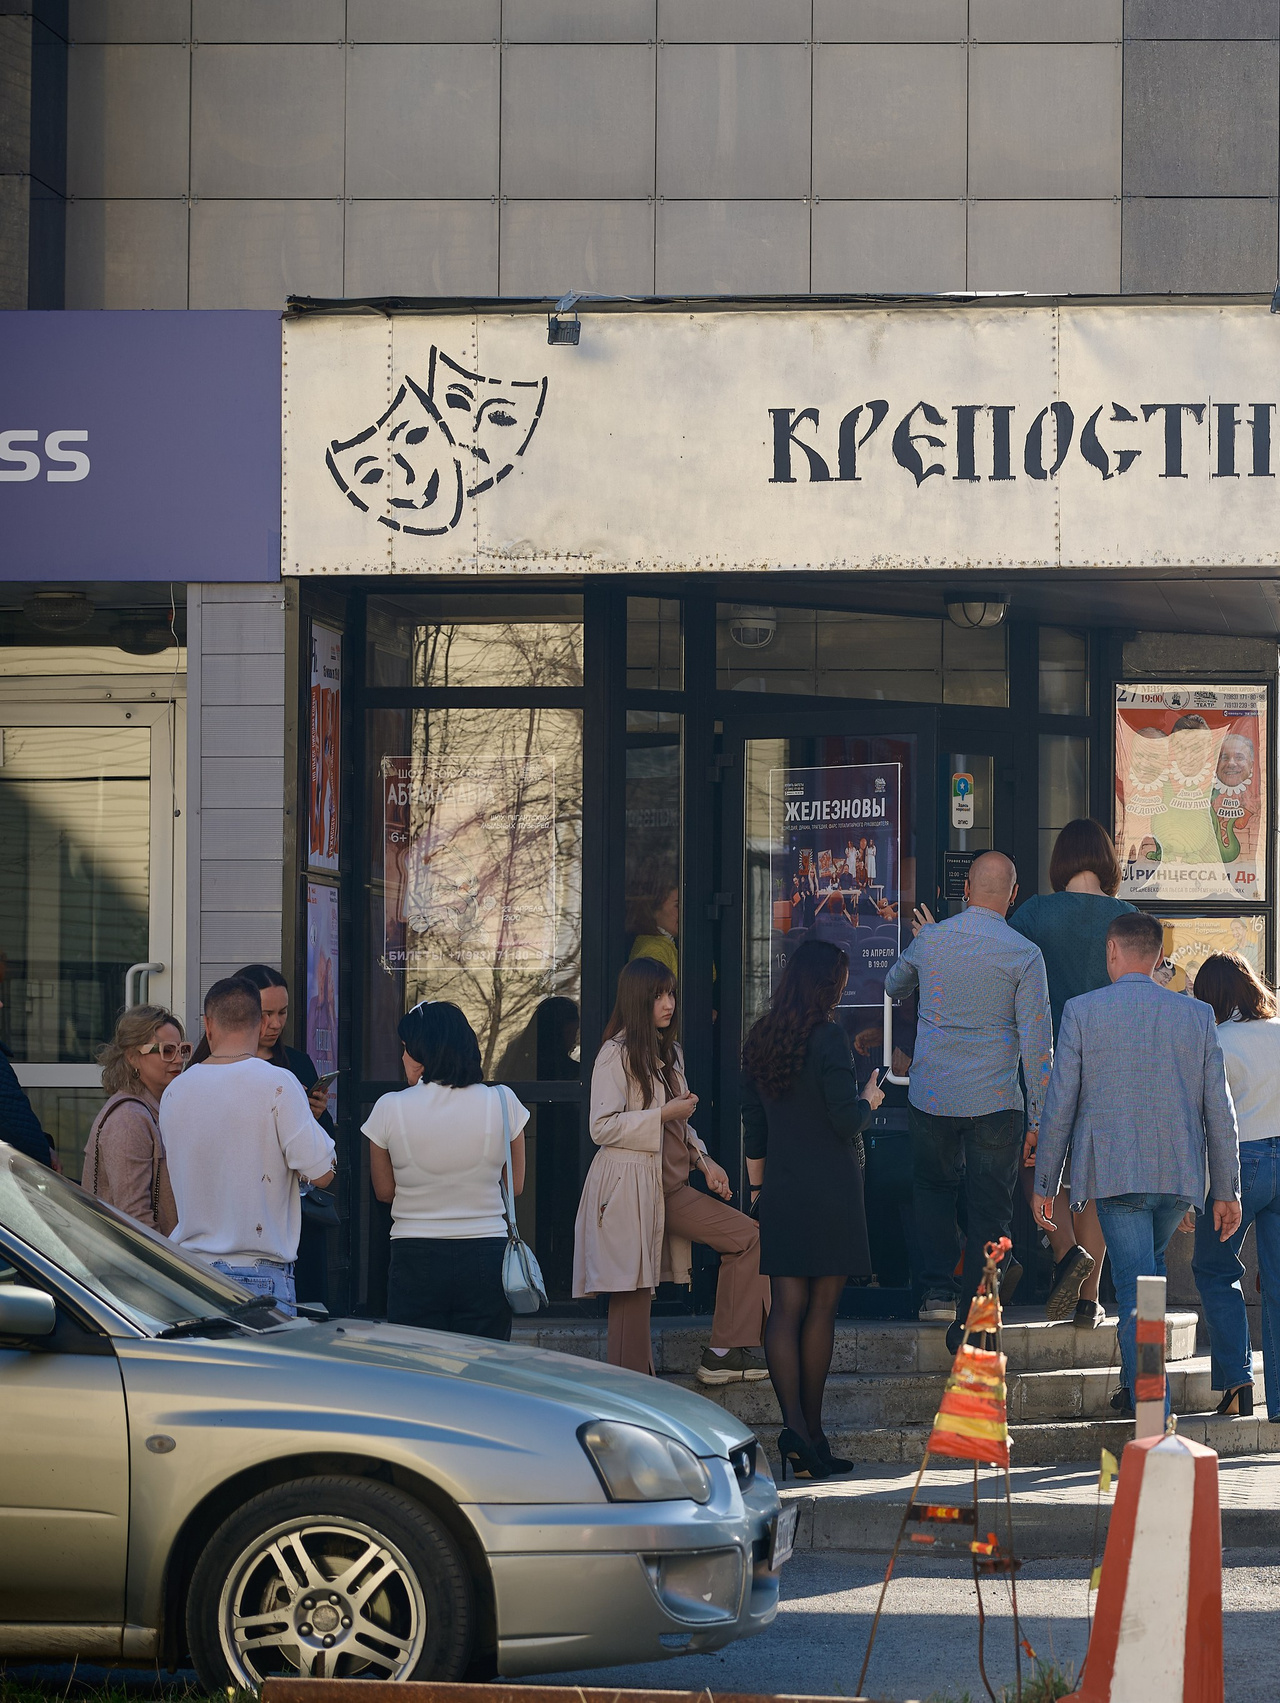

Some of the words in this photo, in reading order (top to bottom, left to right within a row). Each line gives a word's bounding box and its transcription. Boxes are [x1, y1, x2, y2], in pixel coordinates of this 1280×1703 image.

[1141, 694, 1164, 703] 19:00
[784, 797, 886, 822] ЖЕЛЕЗНОВЫ
[1218, 808, 1245, 818] ВИНС
[390, 832, 408, 843] 6+
[862, 949, 870, 957] 29
[870, 948, 895, 957] АПРЕЛЯ
[873, 960, 889, 968] 19:00
